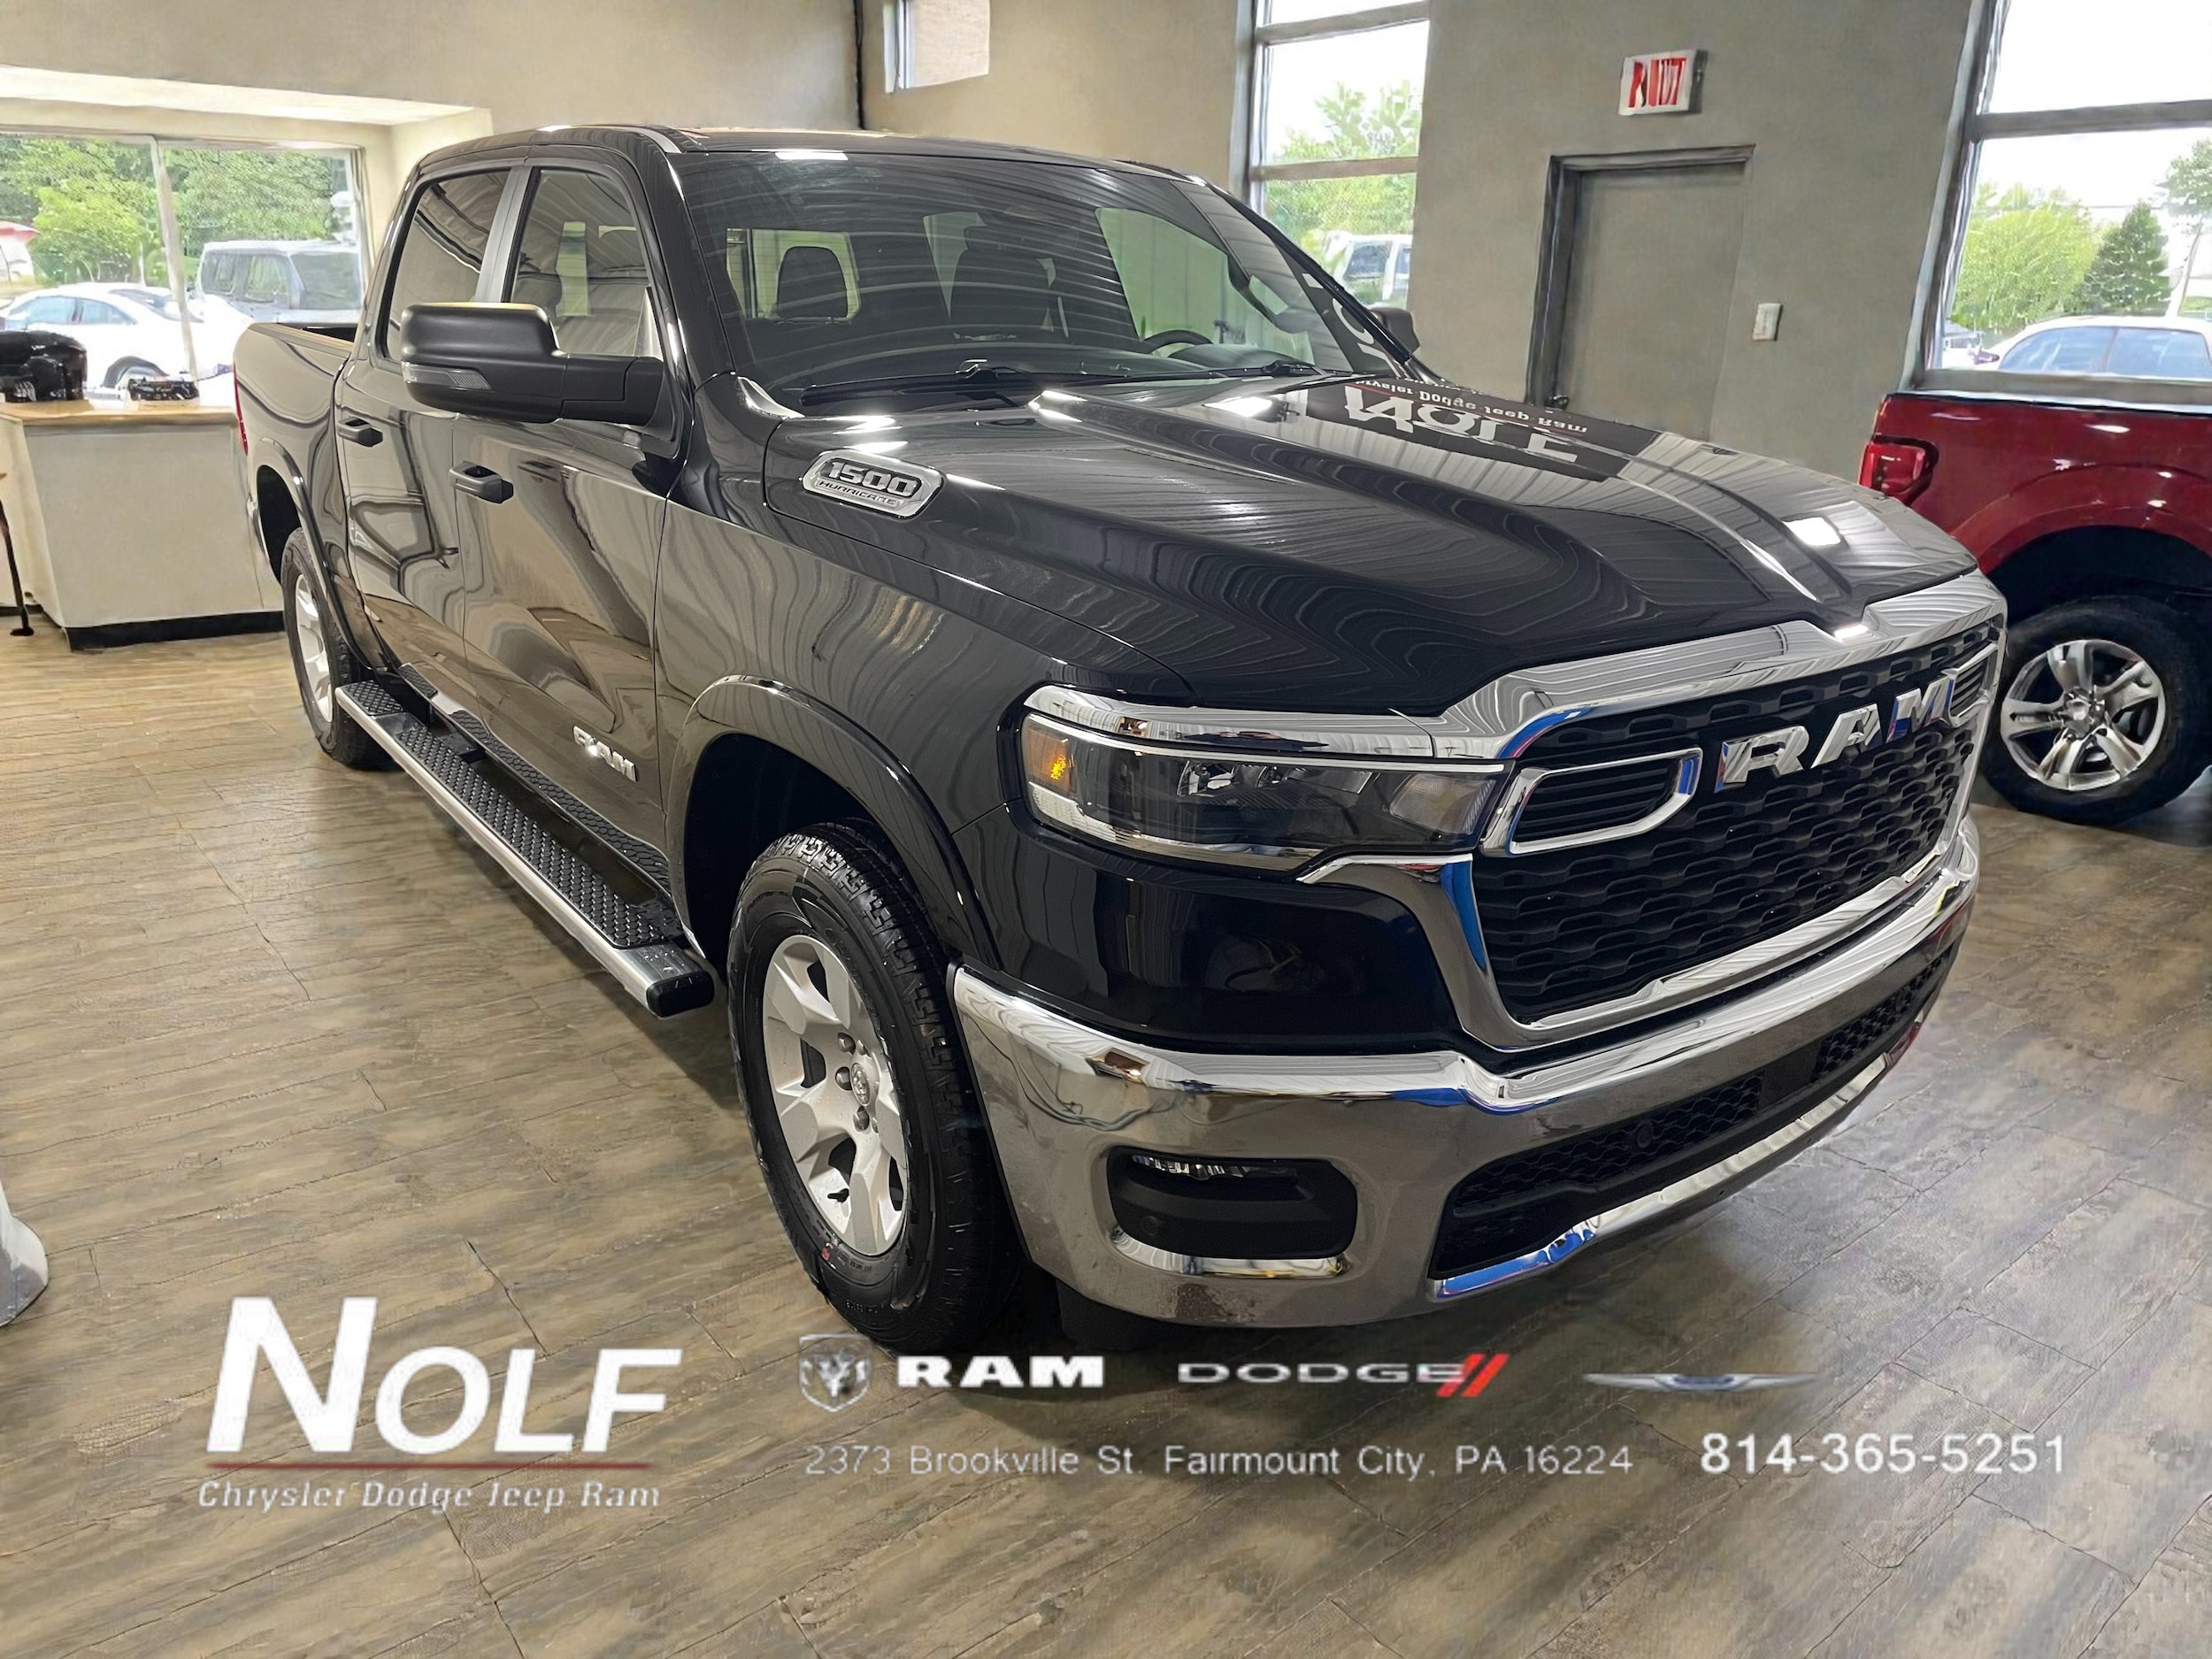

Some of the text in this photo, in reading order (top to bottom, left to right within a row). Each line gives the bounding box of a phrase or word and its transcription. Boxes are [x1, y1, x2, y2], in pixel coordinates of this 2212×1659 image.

[818, 480, 896, 506] HURRICANE
[828, 462, 919, 497] 1500
[572, 726, 637, 782] RAM
[1714, 676, 1949, 794] RAM
